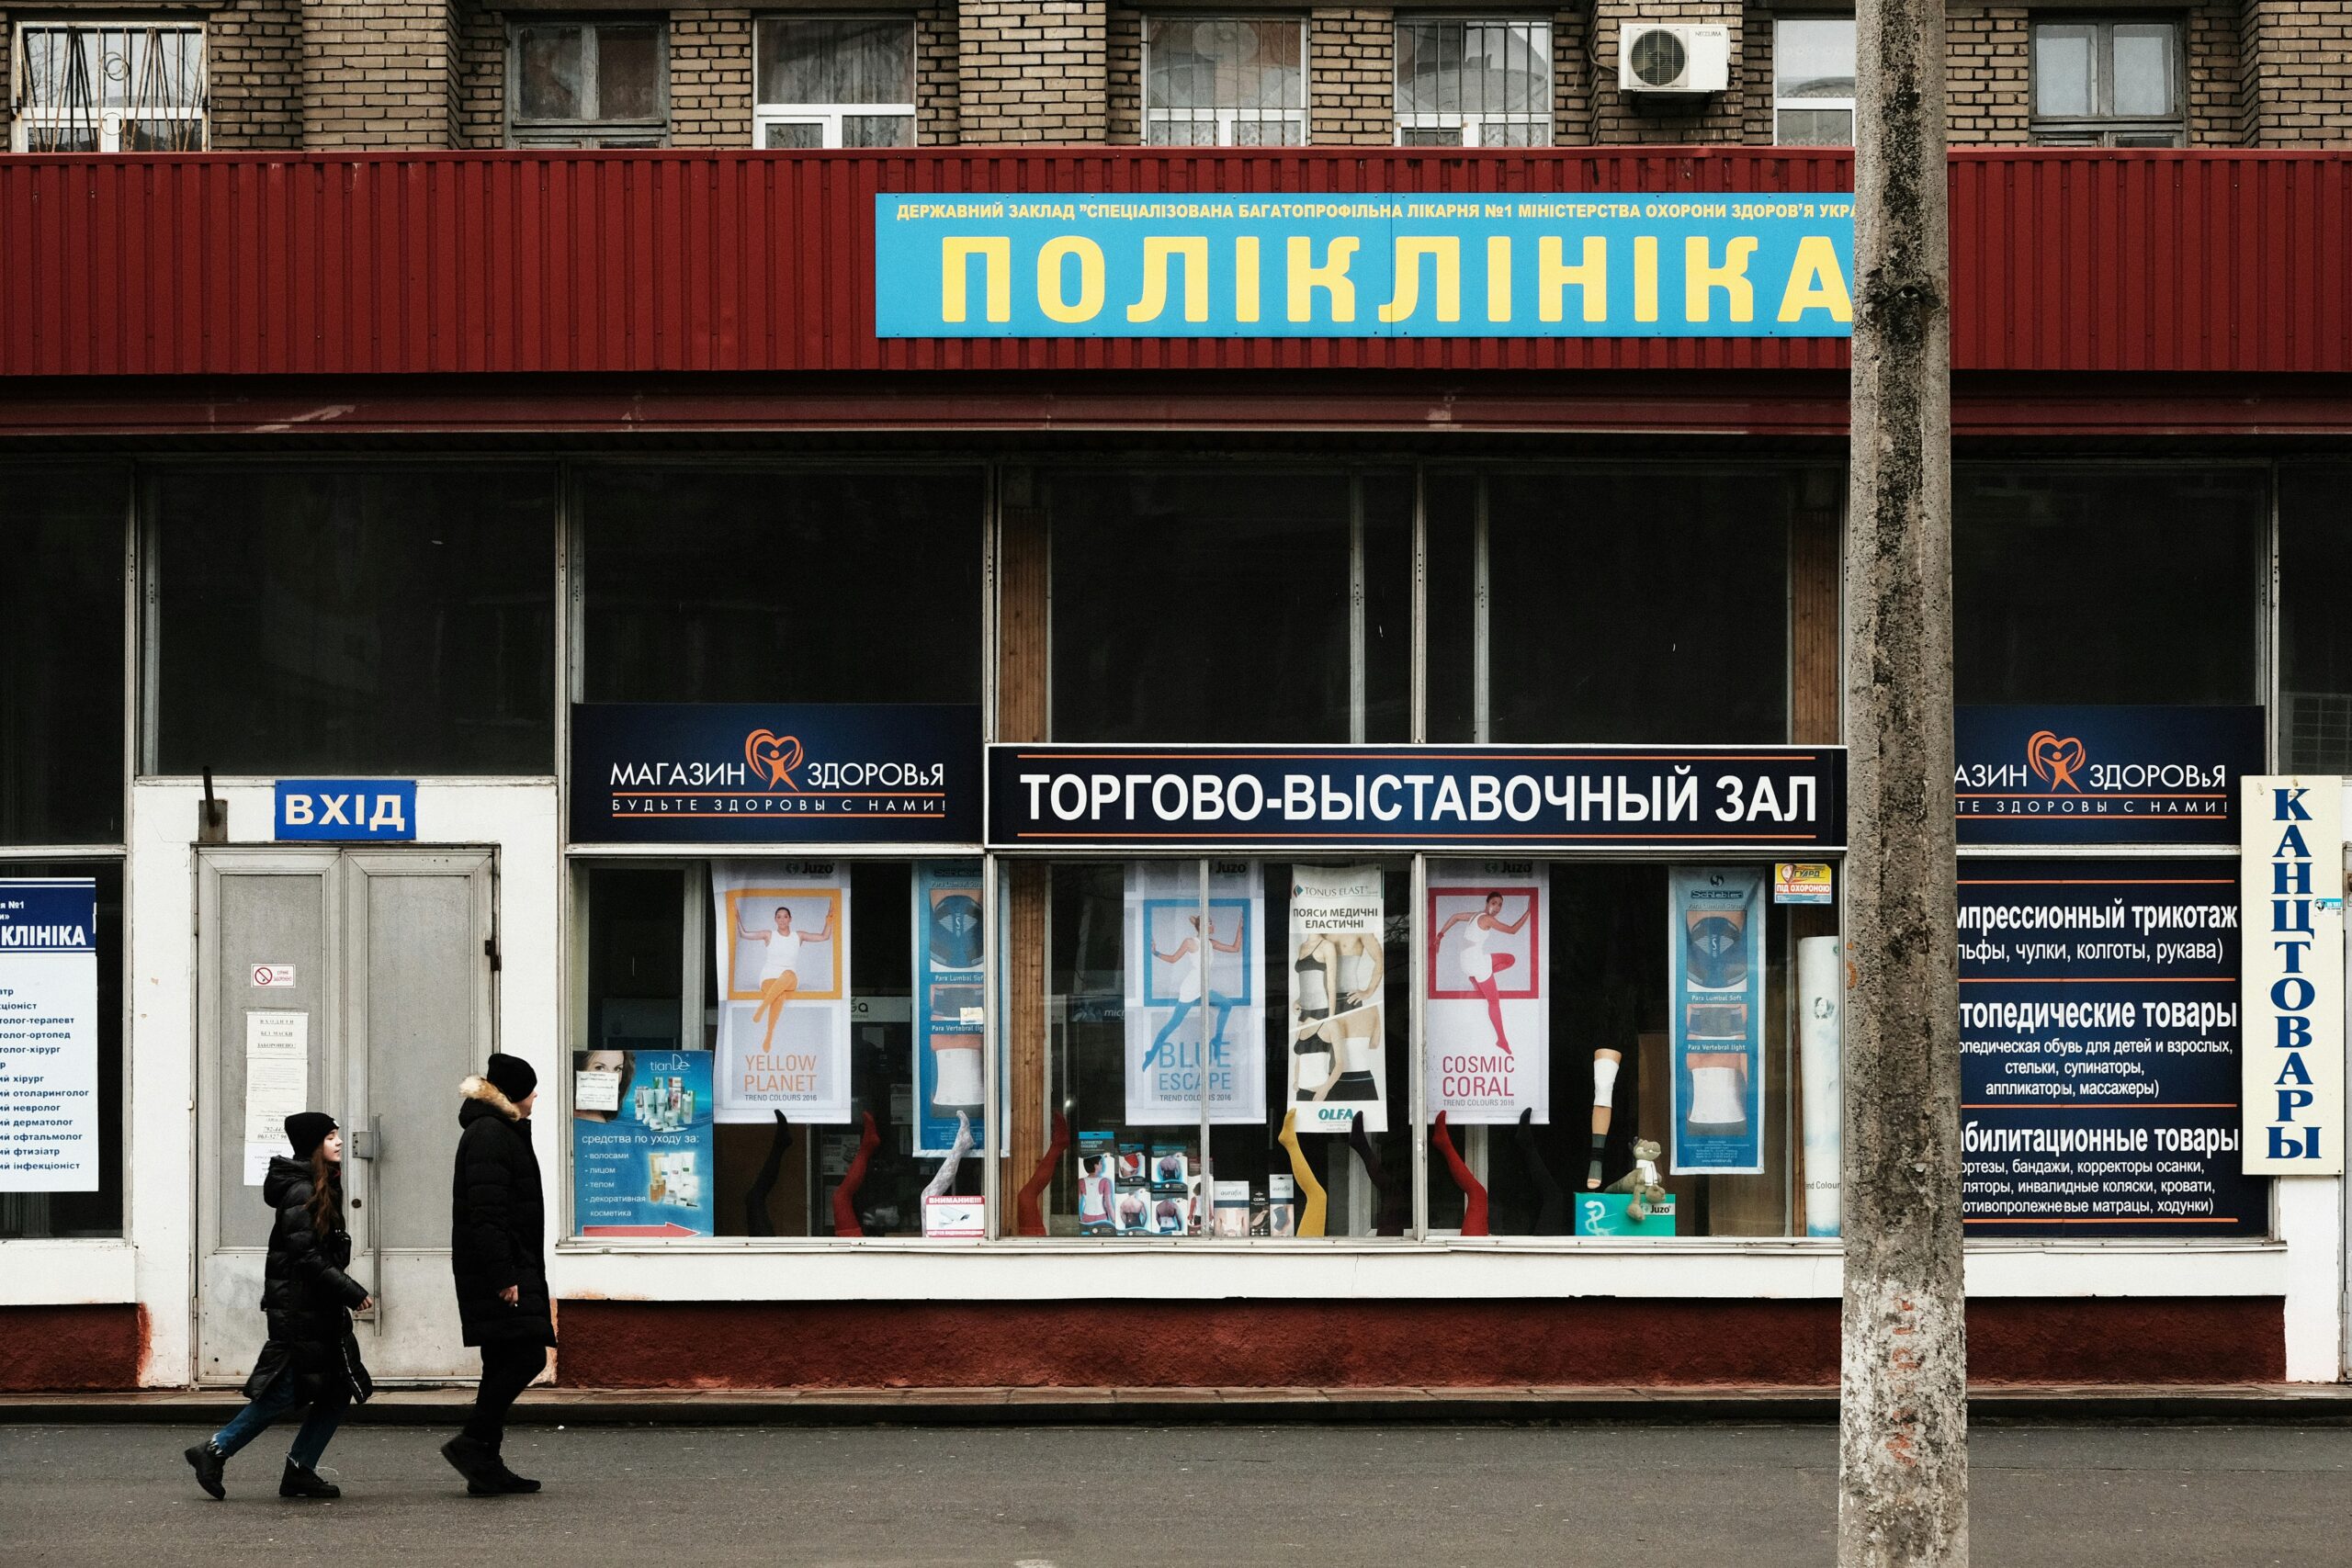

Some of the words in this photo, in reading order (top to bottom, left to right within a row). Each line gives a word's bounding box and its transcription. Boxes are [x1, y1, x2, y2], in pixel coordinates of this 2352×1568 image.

[897, 201, 1003, 220] ДЕРЖАВНИЙ
[1009, 204, 1075, 220] ЗАКЛАД
[1238, 204, 1403, 220] БАГАТОПРОФІЛЬНА
[1408, 204, 1480, 219] ЛІКАРНЯ
[1484, 204, 1512, 219] №1
[1518, 204, 1641, 219] МІНІСТЕРСТВА
[1645, 204, 1727, 219] ОХОРОНИ
[943, 235, 1853, 323] ПОЛІКЛІНІКА
[610, 762, 745, 785] МАГАЗИН
[1020, 765, 1698, 821] ТОРГОВО-ВЫСТАВОЧНЫЙ
[1715, 775, 1816, 822] ЗАЛ
[285, 794, 405, 831] ВХІД
[612, 799, 697, 812] БУДЬТЕ
[714, 799, 825, 812] ЗДОРОВЫ
[842, 799, 853, 811] С
[869, 799, 945, 811] НАМИ!
[1996, 801, 2107, 814] ЗДОРОВЫ
[2124, 801, 2134, 812] С
[2151, 801, 2228, 812] НАМИ!
[1306, 886, 1337, 897] TONUS
[1293, 908, 1327, 917] ПОЯСИ
[1329, 908, 1378, 918] МЕДИЧНІ
[2132, 905, 2238, 936] трикотаж
[1306, 919, 1363, 928] ЕЛАСТИЧНІ
[2, 926, 86, 945] КЛІНІКА
[2016, 942, 2071, 964] чулки,
[2077, 943, 2151, 963] колготы,
[2156, 938, 2223, 964] рукава)
[2266, 788, 2322, 1159] КАНЦТОВАРЫ
[1960, 1001, 2135, 1034] топедические
[2143, 1001, 2237, 1035] товары
[2044, 1039, 2083, 1056] обувь
[2086, 1042, 2110, 1055] для
[2113, 1038, 2152, 1055] детей
[2155, 1041, 2164, 1053] и
[2166, 1041, 2233, 1055] взрослых,
[745, 1055, 817, 1071] YELLOW
[1442, 1056, 1515, 1073] COSMIC
[2005, 1062, 2059, 1076] стельки,
[2064, 1062, 2144, 1076] супинаторы,
[13, 1074, 44, 1084] хірург
[744, 1075, 817, 1091] PLANET
[1442, 1077, 1514, 1097] CORAL
[13, 1089, 89, 1098] отоларинголог
[1985, 1082, 2075, 1098] аппликаторы,
[2079, 1079, 2159, 1098] массажеры)
[13, 1104, 61, 1112] невролог
[1318, 1109, 1353, 1120] OLFA
[13, 1119, 74, 1127] дерматолог
[13, 1133, 83, 1142] офтальмолог
[582, 1135, 631, 1145] средства
[650, 1136, 681, 1145] уходу
[2154, 1128, 2239, 1158] товары
[13, 1146, 60, 1156] фтизіатр
[13, 1161, 80, 1171] інфекціоніст
[2012, 1159, 2074, 1175] бандажи,
[2077, 1162, 2153, 1176] корректоры
[2156, 1162, 2204, 1175] осанки,
[2018, 1181, 2099, 1195] инвалидные
[2103, 1180, 2157, 1194] коляски,
[2161, 1180, 2215, 1194] кровати,
[1650, 1204, 1669, 1213] Juzo
[2092, 1201, 2154, 1214] матрацы,
[2157, 1198, 2213, 1214] ходунки)
